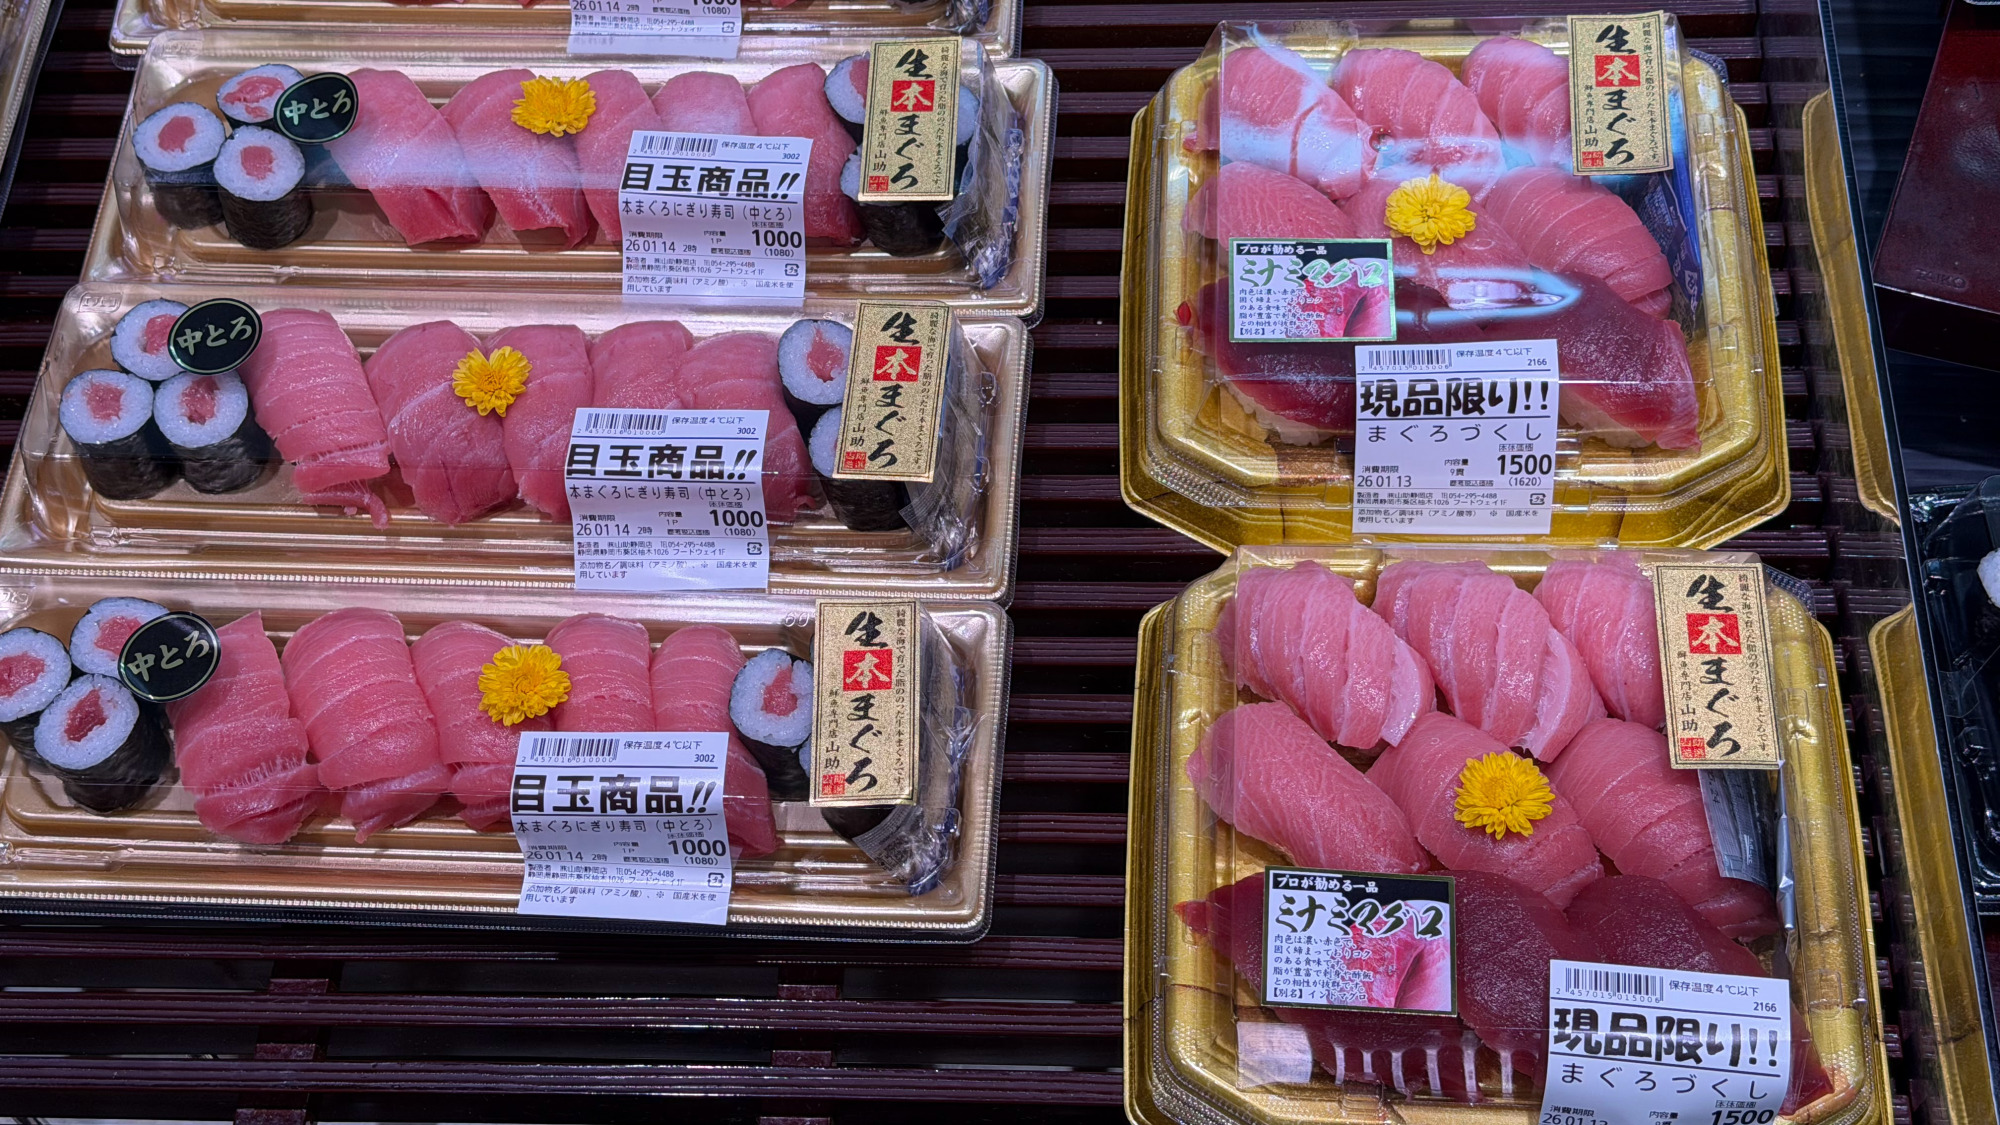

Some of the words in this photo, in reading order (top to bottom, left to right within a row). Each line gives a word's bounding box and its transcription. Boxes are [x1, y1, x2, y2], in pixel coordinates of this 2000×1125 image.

[702, 7, 731, 15] (1080)
[1596, 24, 1638, 165] 生本まぐろ
[282, 89, 350, 126] 中とろ
[890, 48, 933, 190] 生本まぐろ
[621, 163, 800, 200] 目玉商品!!
[622, 198, 792, 221] 本まぐろにぎり寿司（中とろ）
[752, 230, 801, 248] 1000
[764, 249, 794, 257] (1080)
[1239, 245, 1327, 255] プロが勧める一品
[176, 316, 253, 356] 中とろ
[868, 311, 920, 468] 生本まぐろ
[1360, 378, 1549, 417] 現品限り!!
[1369, 423, 1541, 442] まぐろづくし
[566, 444, 757, 480] 目玉商品!!
[1497, 454, 1552, 476] 1500
[1450, 469, 1464, 477] 9貫
[1508, 477, 1542, 487] (1620)
[569, 484, 751, 501] 本まぐろにぎり寿司（中とろ）
[709, 509, 764, 528] 1000
[1357, 516, 1414, 524] 使用しています
[127, 630, 209, 682] 中とろ
[1686, 574, 1741, 757] 生本まぐろ
[845, 611, 891, 793] 生本まぐろ
[694, 754, 715, 763] 3002
[512, 774, 717, 814] 目玉商品!!
[517, 819, 713, 833] 本まぐろにぎり寿司（中とろ）
[667, 839, 727, 857] 1000
[685, 856, 719, 866] (1080)
[1277, 875, 1378, 893] プロが勧める一品
[1275, 894, 1444, 940] ミナミマグロ
[1274, 946, 1371, 959] 固く締まっておりコク
[1274, 957, 1346, 969] のある食味です。
[1272, 988, 1368, 1000] 【別名】インドマグロ
[1669, 980, 1759, 997] 保存温度4℃以下
[1753, 1001, 1777, 1012] 2166
[1554, 1008, 1778, 1067] 現品限り!!
[1562, 1063, 1768, 1100] まぐろづくし
[1711, 1109, 1774, 1125] 1500
